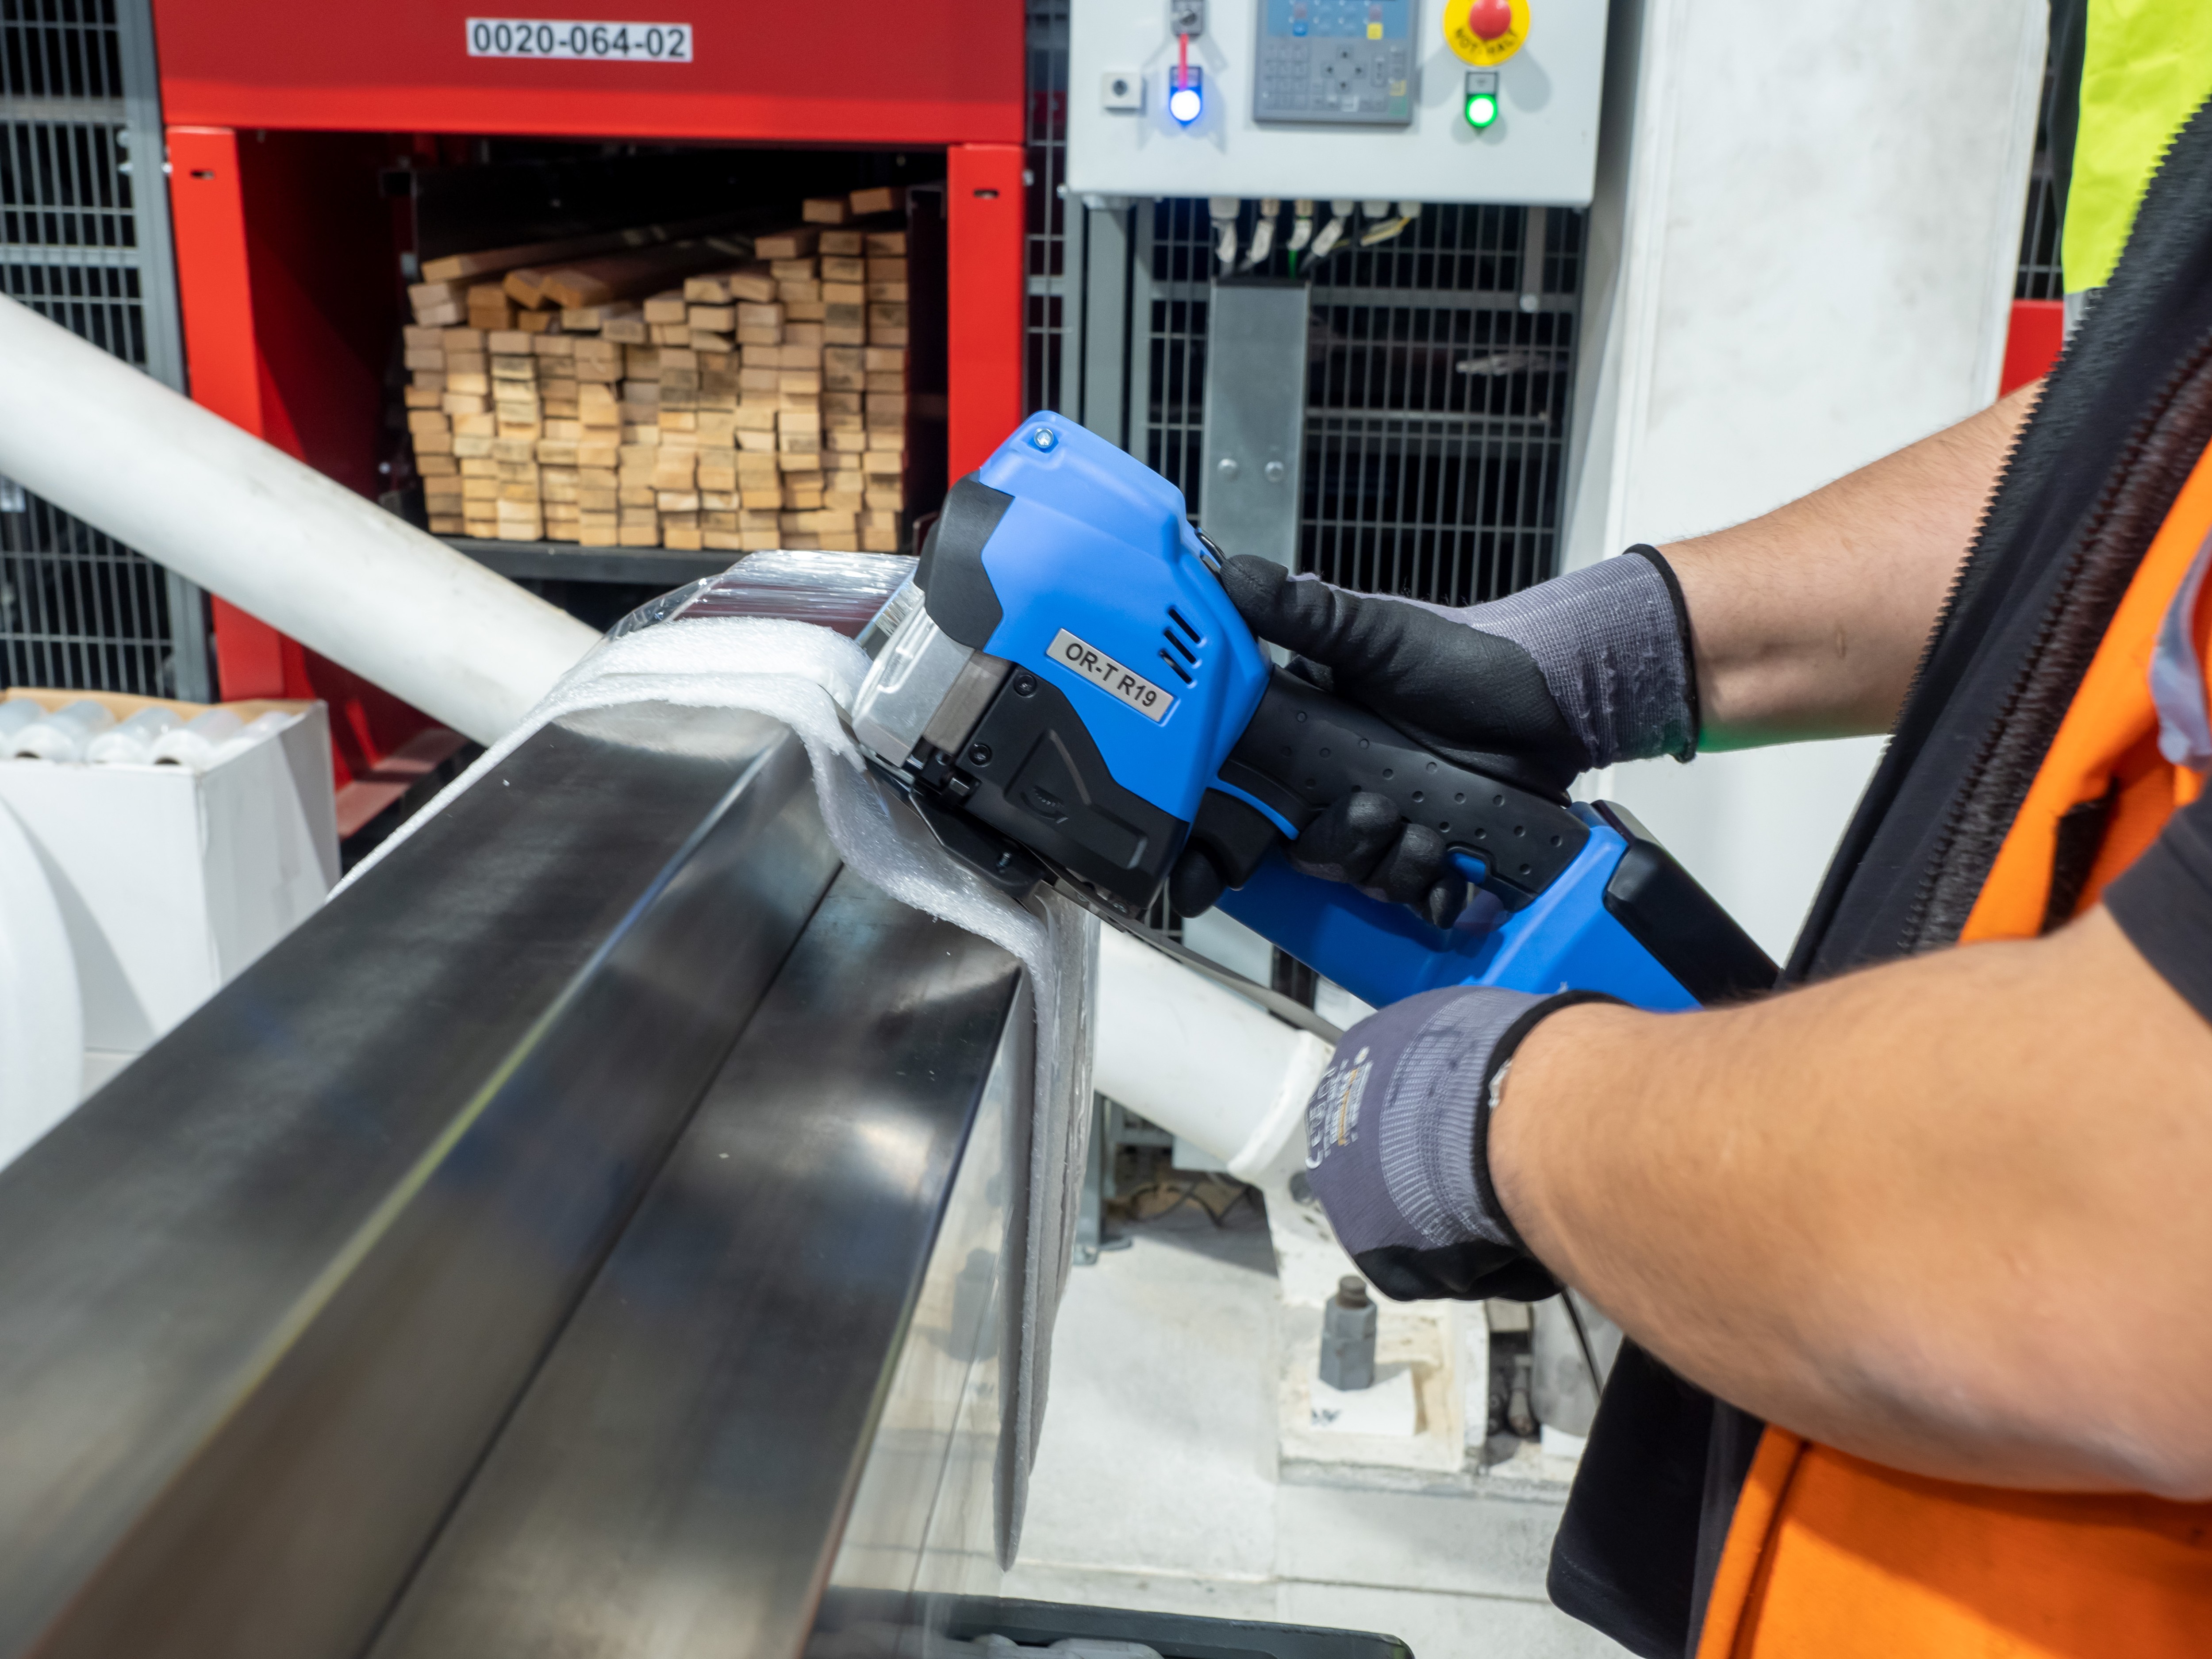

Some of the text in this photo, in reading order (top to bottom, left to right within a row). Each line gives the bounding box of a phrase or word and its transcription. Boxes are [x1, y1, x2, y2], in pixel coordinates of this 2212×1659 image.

[474, 24, 684, 56] 0020-064-02
[1066, 643, 1157, 707] OR-T R19
